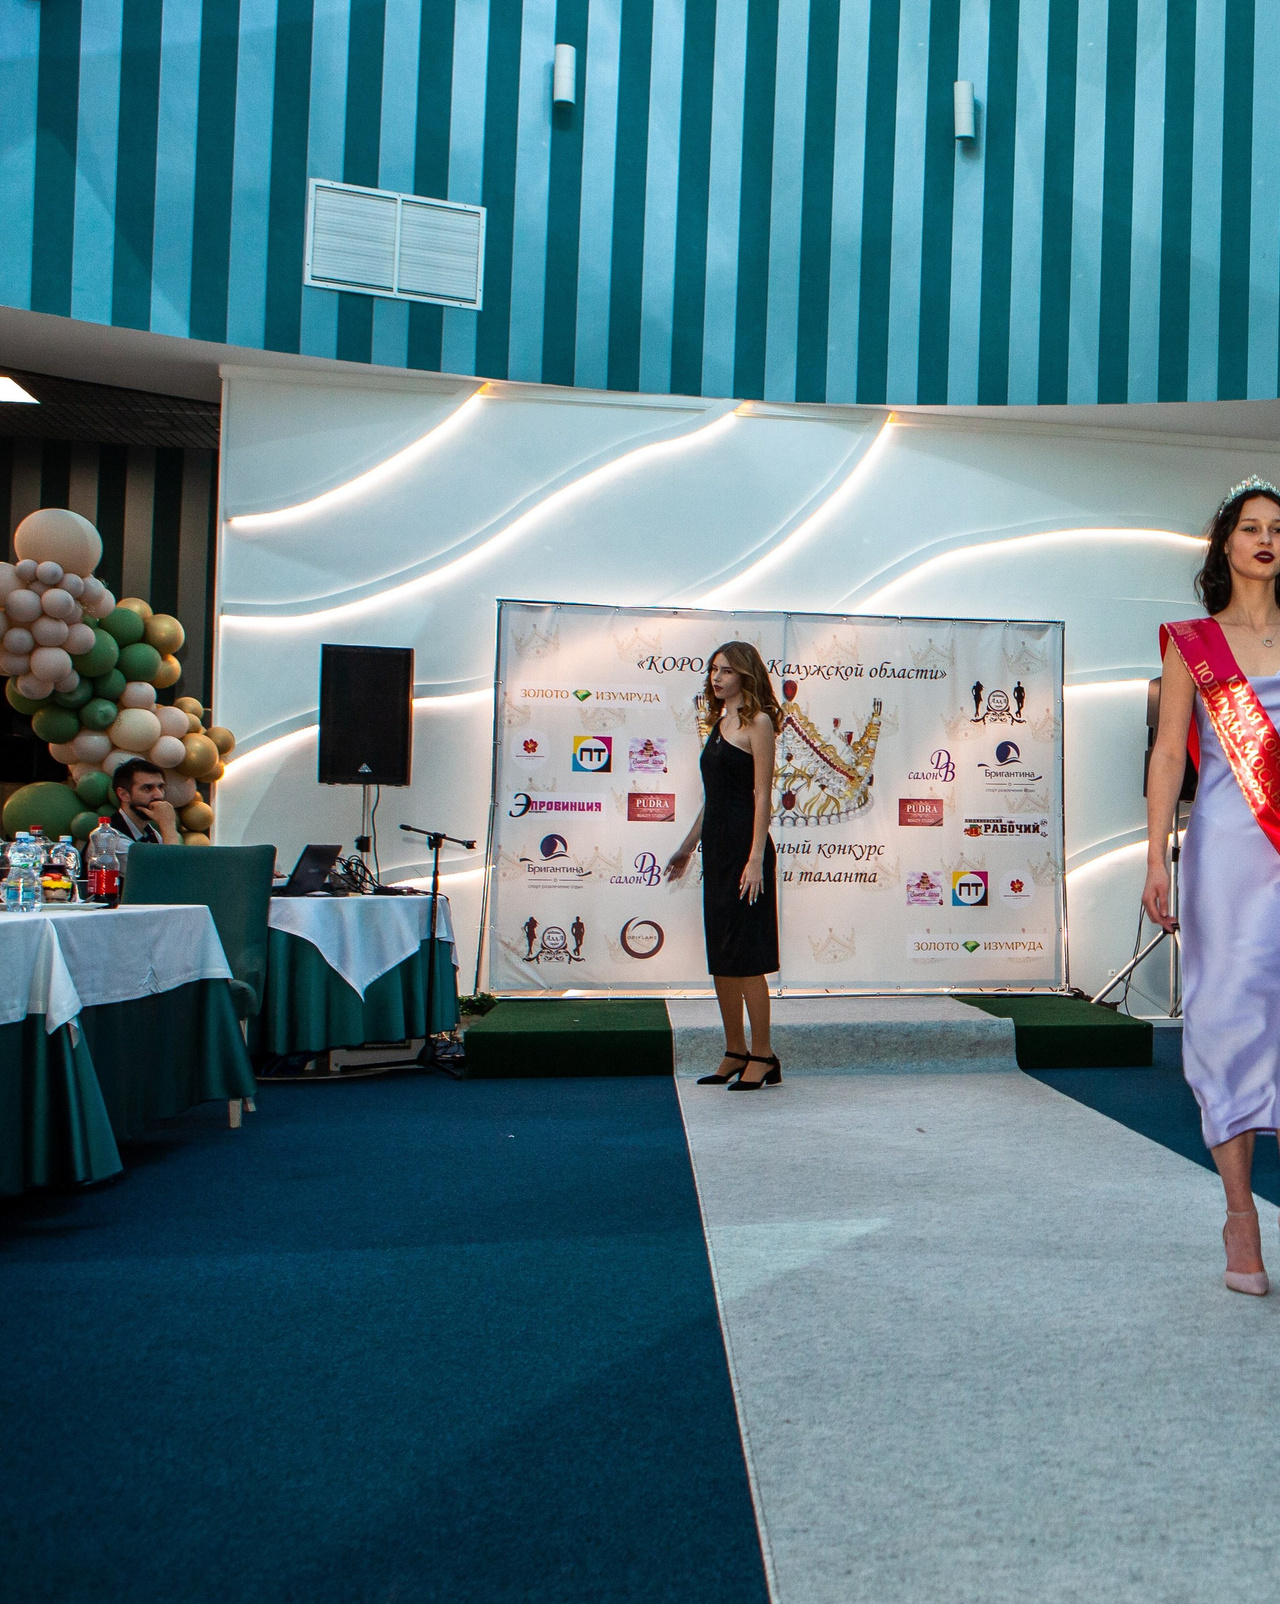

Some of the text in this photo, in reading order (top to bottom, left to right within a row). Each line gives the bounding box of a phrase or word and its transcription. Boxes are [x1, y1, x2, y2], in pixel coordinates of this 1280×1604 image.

[766, 659, 864, 681] Калужской
[868, 661, 948, 680] области»
[520, 688, 661, 704] ЗОЛОТО ИЗУМРУДА
[1194, 660, 1247, 743] ПОДИУМА
[1226, 673, 1264, 727] ЮНАЯ
[579, 747, 607, 762] ПТ
[909, 771, 939, 781] салон
[984, 768, 1036, 780] Бригантина
[636, 799, 670, 809] PUDRA
[906, 804, 938, 814] PUDRA
[983, 821, 1041, 834] РАБОЧИЙ
[817, 842, 886, 861] конкурс
[527, 863, 584, 876] Бригантина
[609, 874, 642, 885] салон
[800, 870, 878, 884] таланта
[958, 882, 983, 897] ПТ
[913, 941, 1044, 952] ЗОЛОТО ИЗУМРУДА
